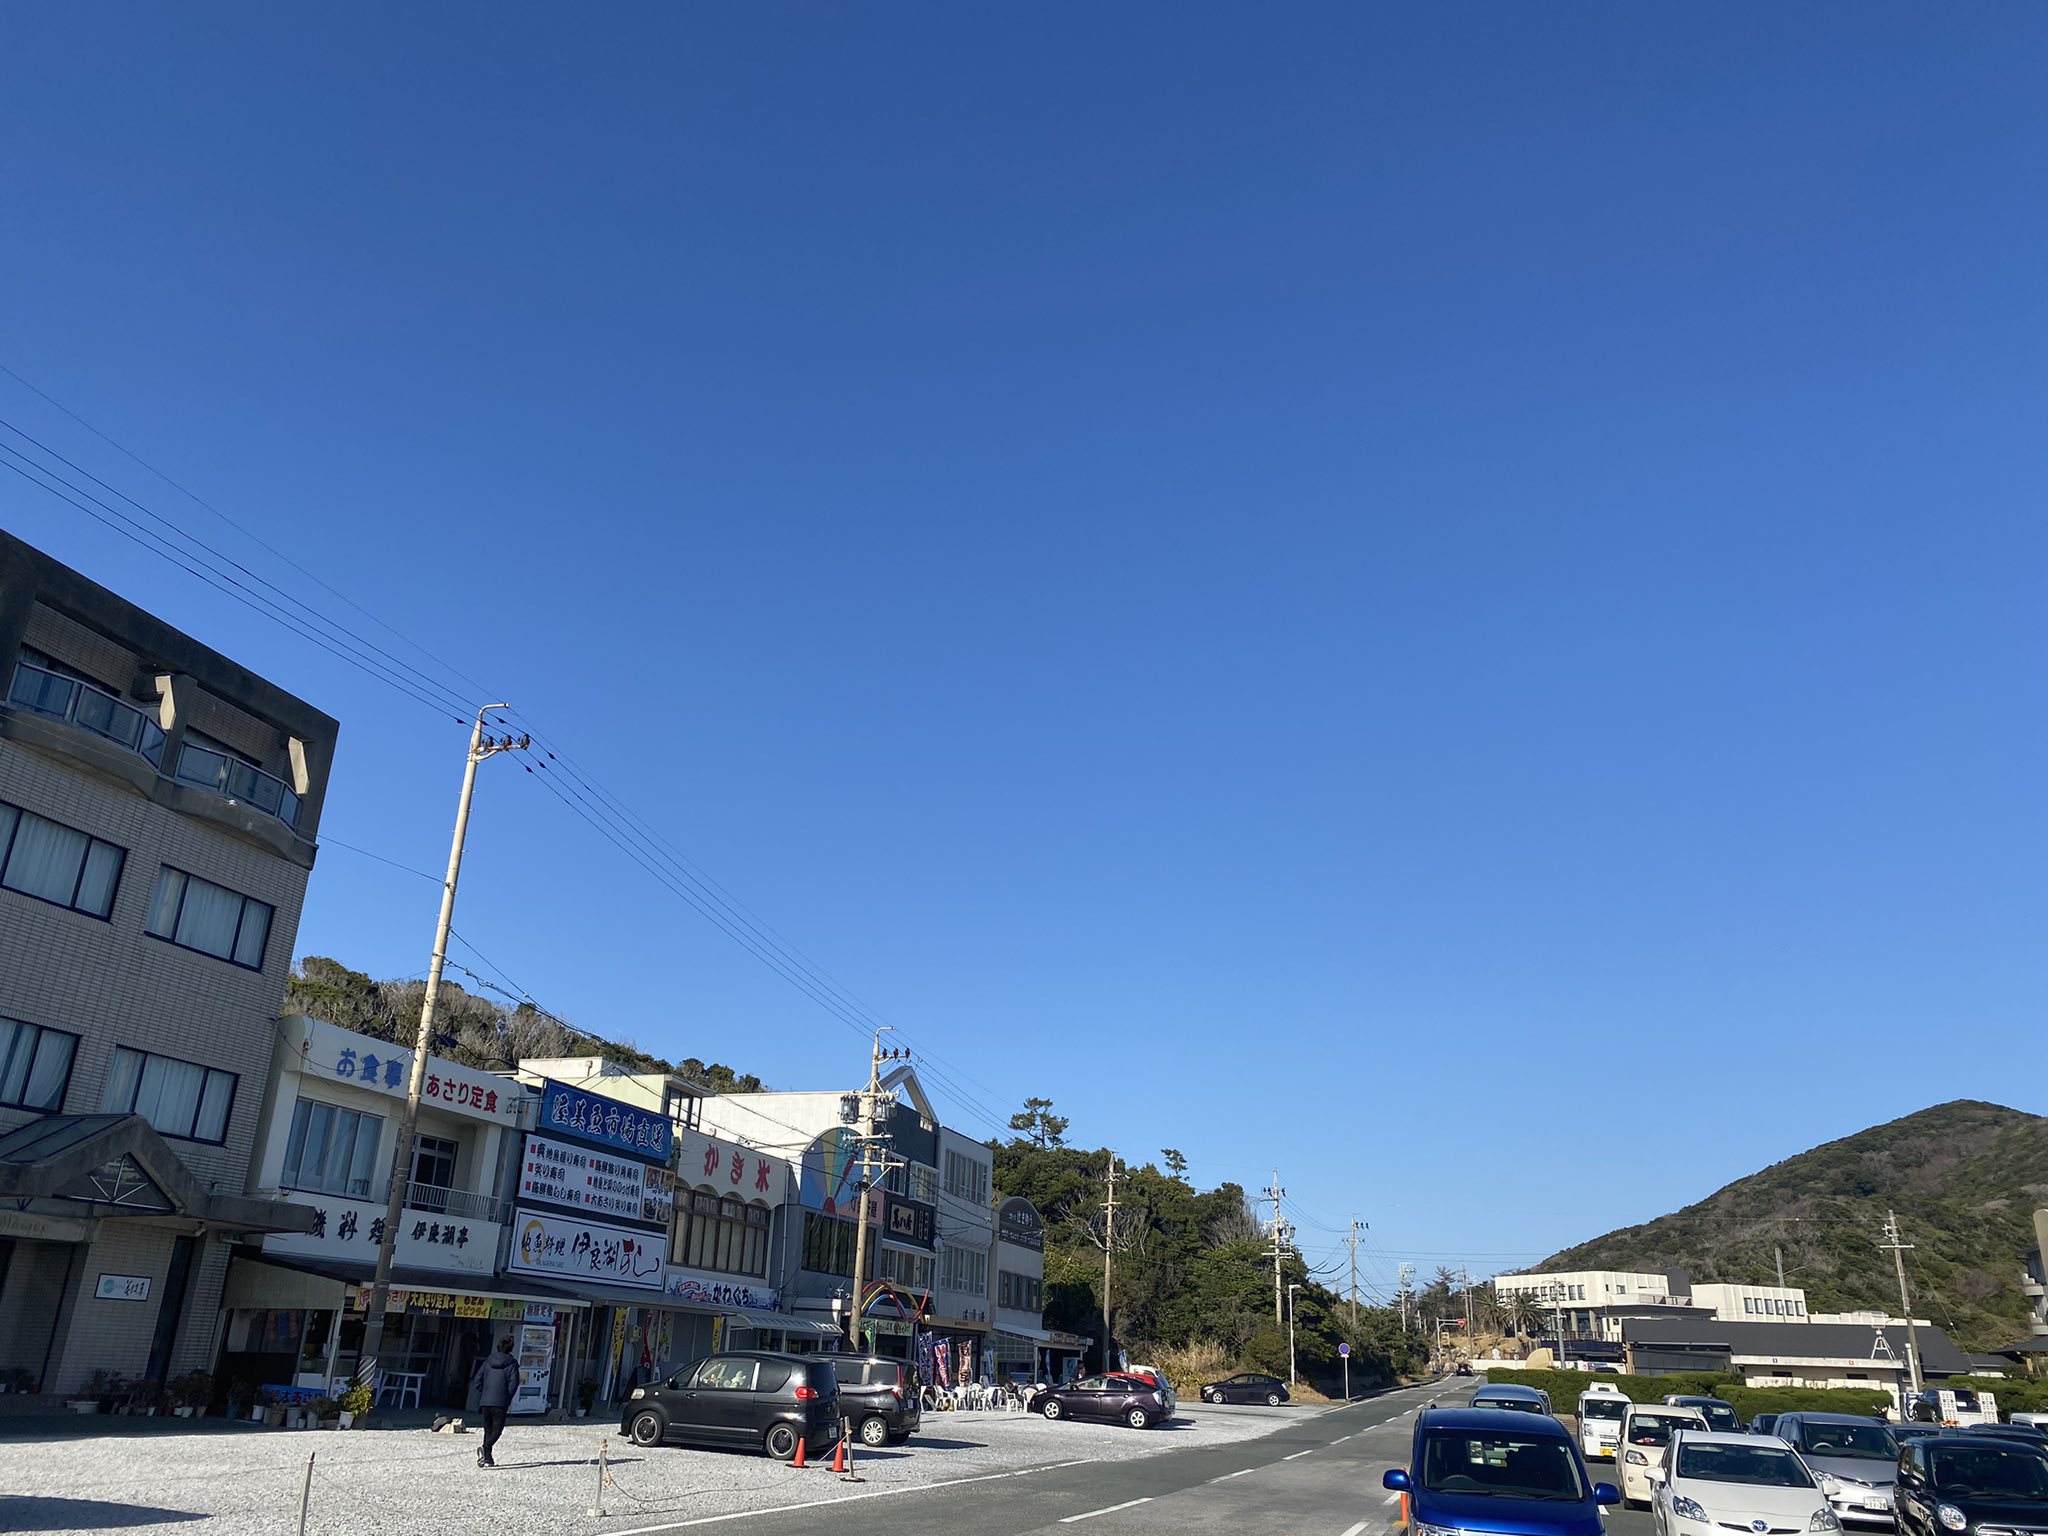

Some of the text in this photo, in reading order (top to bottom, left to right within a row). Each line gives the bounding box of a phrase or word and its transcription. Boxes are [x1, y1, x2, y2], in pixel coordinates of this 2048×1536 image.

[337, 1048, 404, 1089] お食事
[425, 1074, 499, 1113] あさり定食
[703, 1143, 771, 1192] かき氷
[411, 1220, 469, 1249] 伊良湖亭
[711, 1282, 750, 1307] かわぐち
